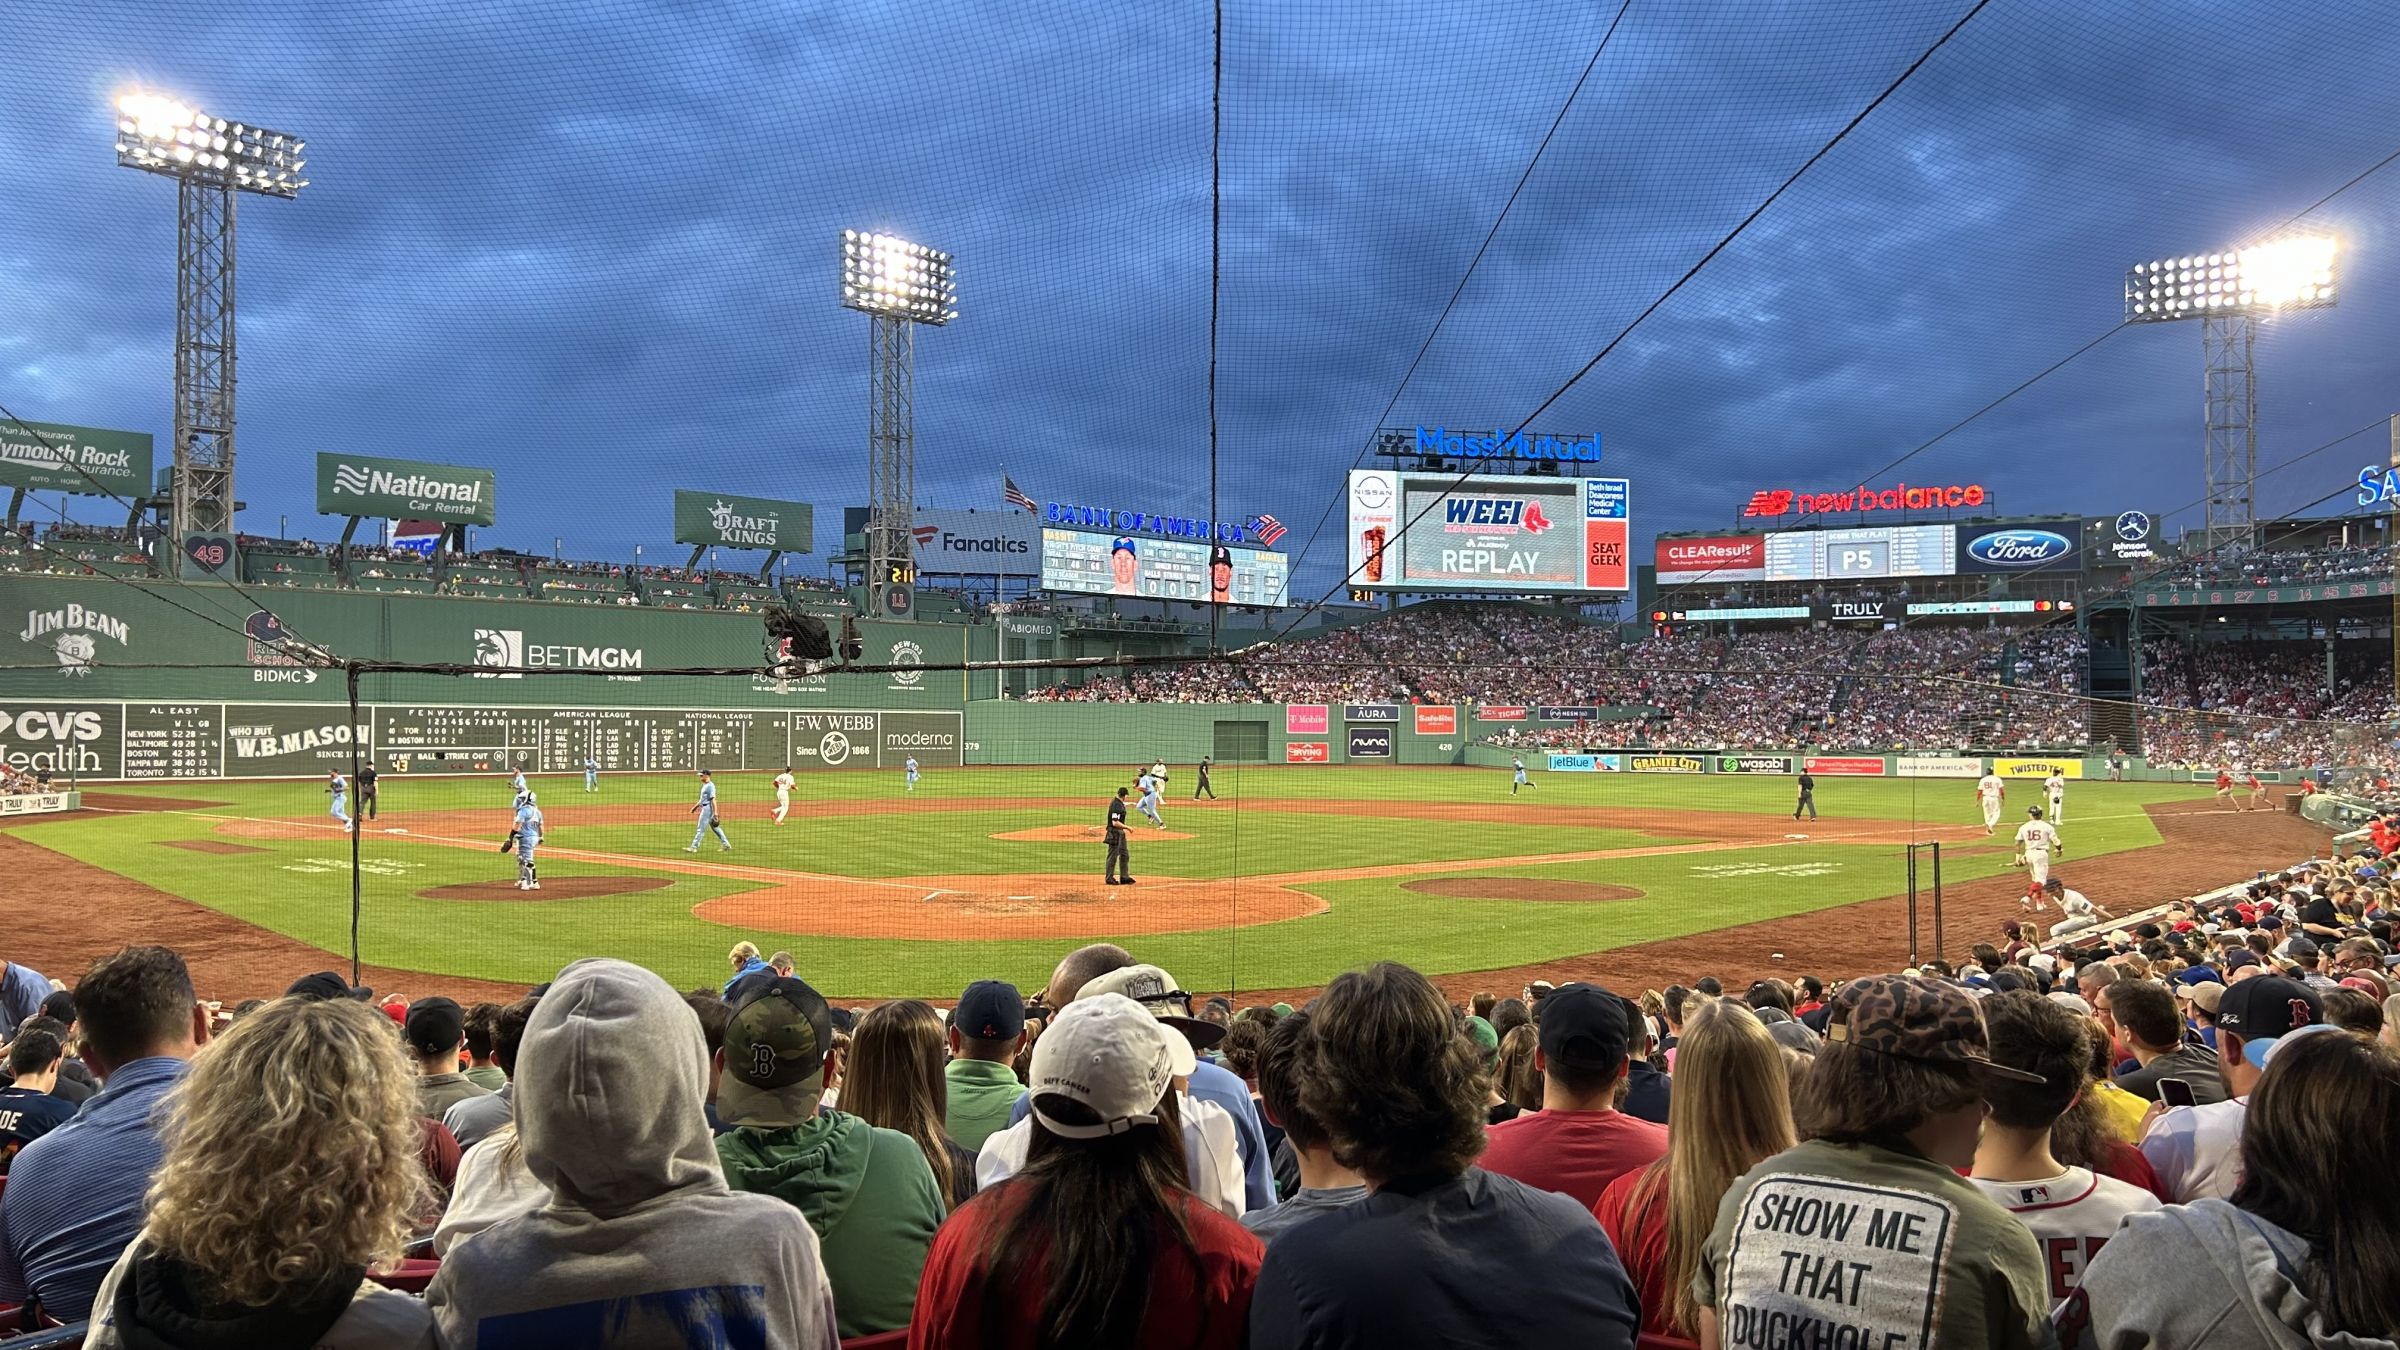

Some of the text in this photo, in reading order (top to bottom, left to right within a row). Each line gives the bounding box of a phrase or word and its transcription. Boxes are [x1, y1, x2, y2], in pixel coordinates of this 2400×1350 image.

[1415, 424, 1601, 462] MassMutual
[81, 445, 131, 468] Rock
[30, 475, 81, 486] AUTO HOME
[369, 470, 481, 503] National
[1588, 483, 1623, 492] Beth Israel
[1588, 491, 1624, 500] Deaconess
[1798, 482, 1985, 514] new balance
[408, 500, 476, 515] Car Rental
[1588, 499, 1615, 508] Medical
[1446, 498, 1524, 525] WEEI
[1588, 507, 1612, 515] Center
[712, 513, 779, 532] DRAFT
[1048, 501, 1246, 543] BANK OF AMERICA
[720, 528, 777, 546] KINGS
[1868, 531, 1888, 539] PLAY
[943, 532, 1028, 553] Fanatics
[1592, 542, 1622, 554] SEAT
[1987, 535, 2050, 560] Ford
[2112, 542, 2147, 552] Johnson
[1668, 543, 1752, 559] CLEAResult
[2118, 549, 2154, 559] Controls
[1442, 549, 1540, 575] REPLAY
[1591, 555, 1622, 567] GEEK
[1842, 549, 1872, 571] P5
[892, 567, 914, 583] 2:11
[1149, 580, 1197, 597] 0 0 3
[2234, 590, 2255, 604] 27
[1832, 602, 1884, 616] TRULY
[20, 603, 131, 646] JIM BEAM
[1010, 624, 1053, 635] ABIOMED
[528, 645, 642, 669] BETMGM
[254, 669, 301, 683] BIDMC
[149, 707, 200, 715] AL EAST
[408, 709, 464, 717] FENWAY
[1498, 709, 1526, 719] TICKET
[198, 720, 210, 728] GB
[795, 715, 875, 731] F.W. WEBB
[1418, 714, 1453, 723] Safelite
[15, 710, 102, 741] CVS
[228, 726, 273, 737] WHO BUT
[403, 727, 419, 735] TOR
[127, 730, 196, 738] NEW YORK 52 28
[887, 730, 954, 745] moderna
[127, 740, 196, 748] BALTIMORE 49 28
[964, 742, 980, 751] 379
[1438, 743, 1453, 751] 420
[127, 750, 196, 758] BOSTON 42 36
[316, 751, 344, 759] SINCE
[388, 753, 398, 761] AT
[398, 753, 412, 761] BAT
[444, 752, 469, 760] STRIKE
[796, 746, 870, 756] Since 1866
[127, 759, 151, 767] TAMPA
[153, 759, 168, 767] BAY
[184, 759, 196, 767] 40
[392, 760, 409, 773] 43
[1553, 756, 1589, 769] jetBlue
[1632, 755, 1702, 770] GRANITE CITY
[1739, 758, 1784, 769] wasabi
[126, 768, 207, 777] TORONTO 35 42 15
[2009, 764, 2048, 775] TWISTED
[2027, 829, 2042, 842] 16
[2287, 998, 2311, 1029] B
[750, 1041, 777, 1079] B
[1061, 1078, 1091, 1095] CANCER
[1754, 1193, 1926, 1255] SHOW ME
[1778, 1250, 1873, 1307] THAT
